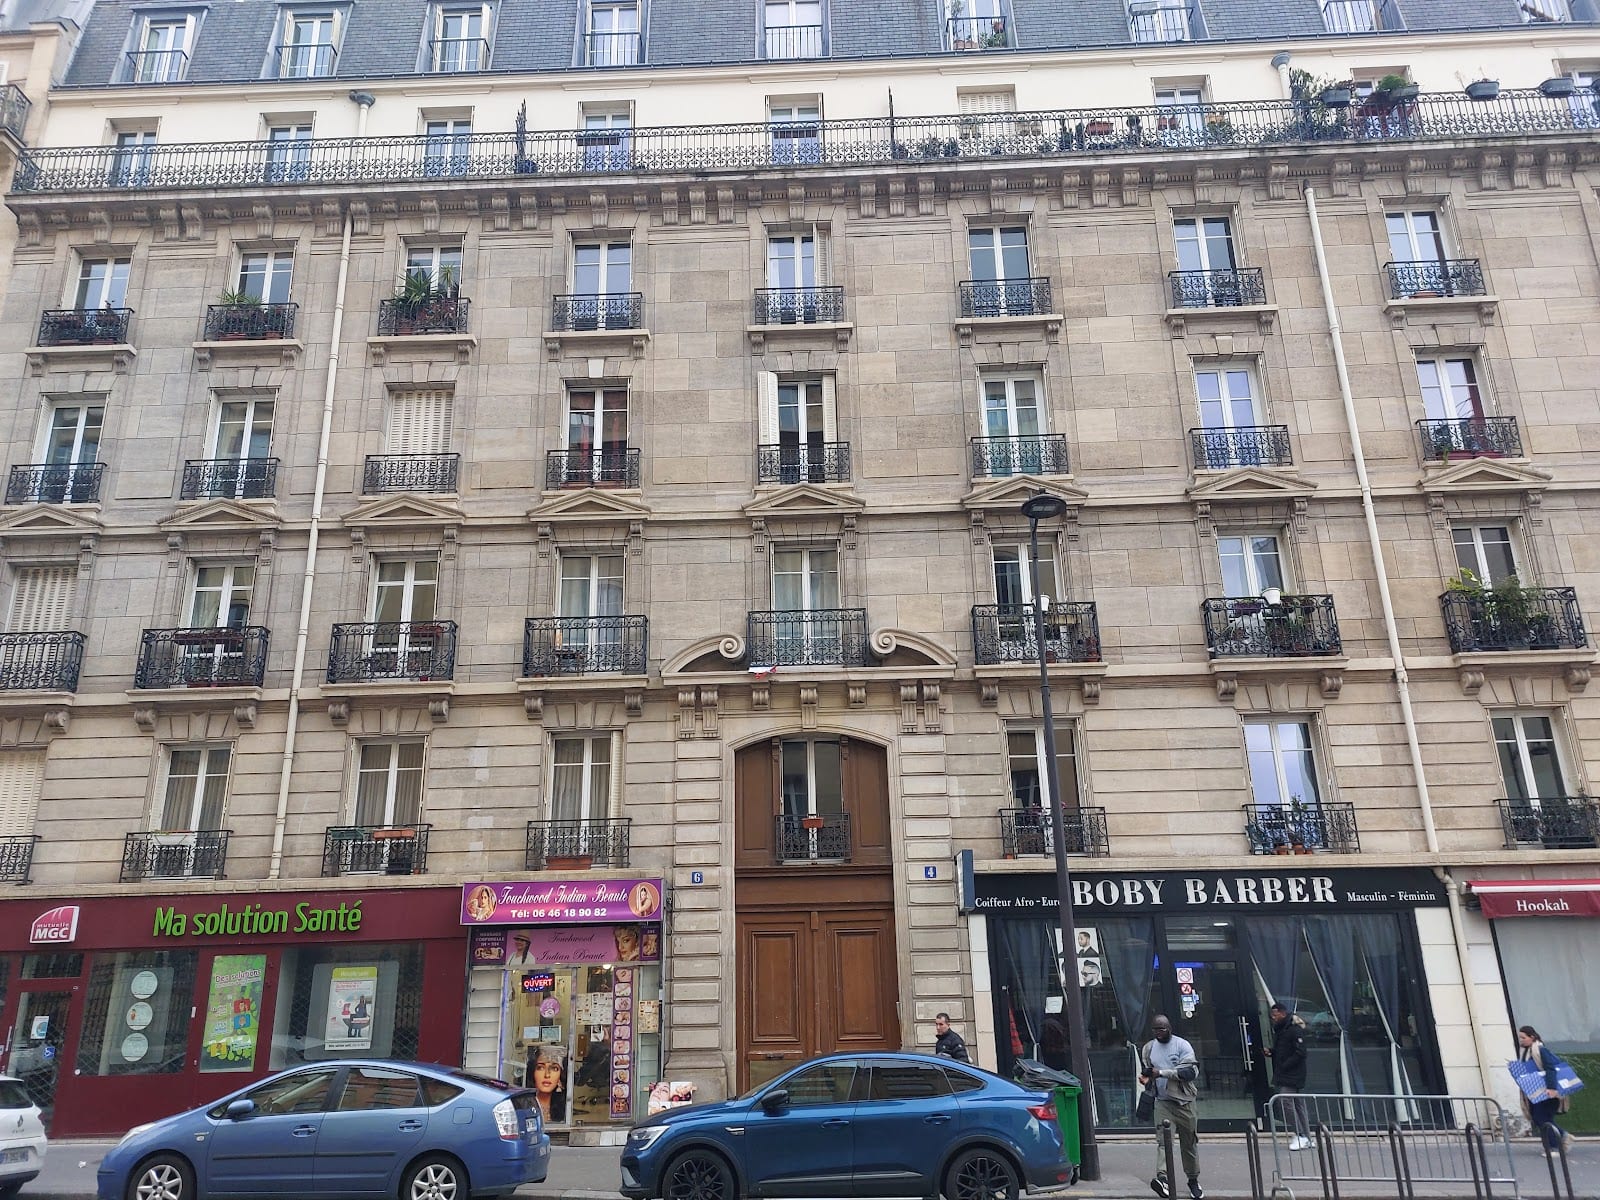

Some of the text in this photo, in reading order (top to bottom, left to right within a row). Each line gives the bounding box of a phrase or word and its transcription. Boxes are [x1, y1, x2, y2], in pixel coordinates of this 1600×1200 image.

[498, 885, 553, 904] Touchwood
[554, 884, 588, 903] Indian
[1071, 876, 1338, 906] BOBY BARBER
[1346, 891, 1388, 902] Masculin
[1398, 890, 1437, 901] Féminin
[975, 897, 1012, 907] Coiffeur
[1516, 898, 1570, 912] Hookah
[153, 900, 362, 936] Ma solution Santé
[532, 909, 546, 918] 06
[547, 909, 561, 918] 46
[563, 908, 577, 917] 18
[578, 908, 593, 917] 90
[594, 907, 608, 917] 82
[34, 928, 69, 939] MGC
[548, 932, 595, 944] Touchwood
[536, 951, 607, 962] Indian Beauté
[523, 978, 553, 988] OUVERT
